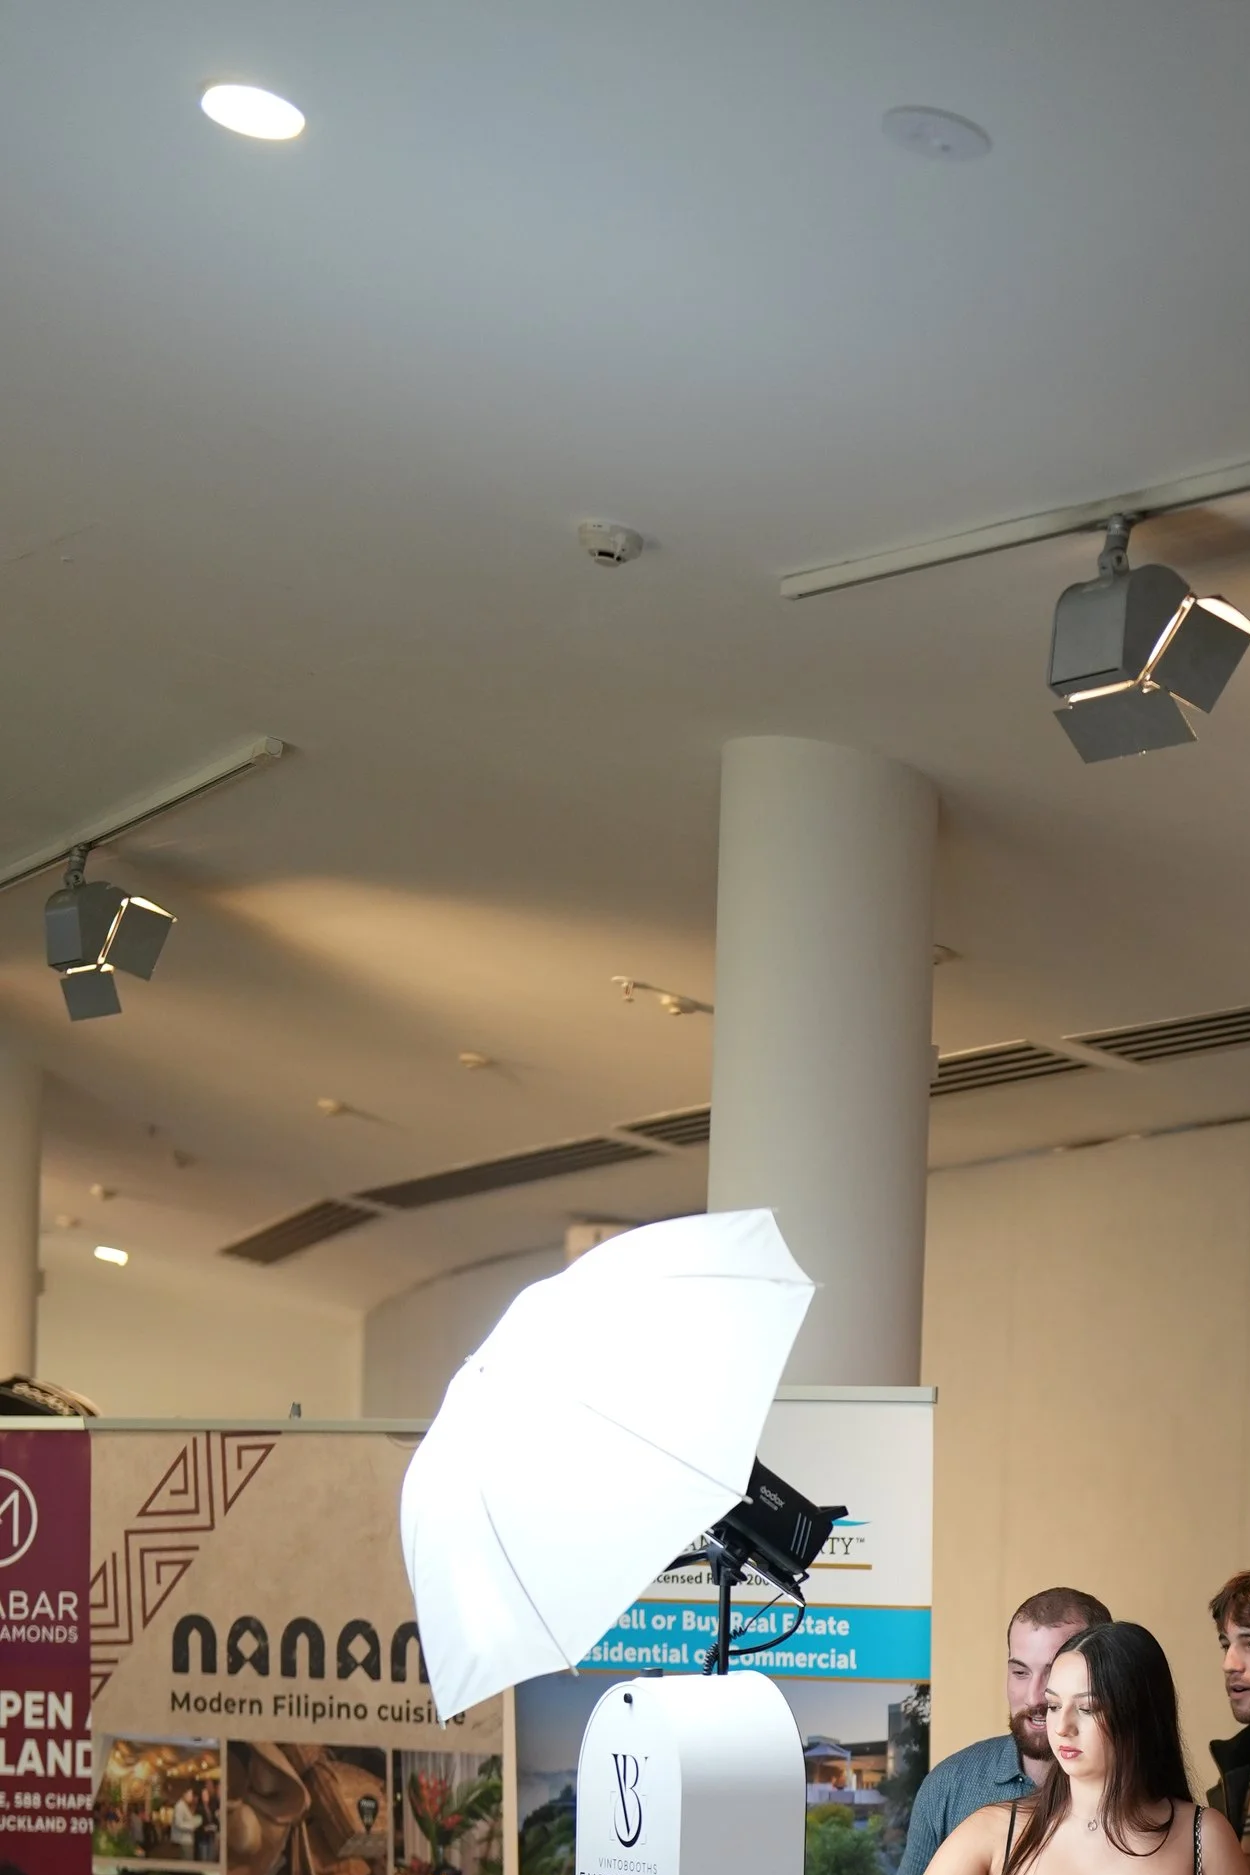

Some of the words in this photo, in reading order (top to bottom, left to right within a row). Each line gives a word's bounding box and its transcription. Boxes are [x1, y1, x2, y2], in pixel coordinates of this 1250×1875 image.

[651, 1614, 677, 1631] or
[682, 1610, 719, 1637] Buy
[732, 1612, 776, 1634] Real
[782, 1613, 850, 1636] Estate
[728, 1646, 858, 1670] Commercial
[170, 1691, 263, 1717] Modern
[273, 1695, 369, 1723] Filipino
[377, 1699, 466, 1726] cuisie
[598, 1857, 658, 1875] VINTOBOOTHS
